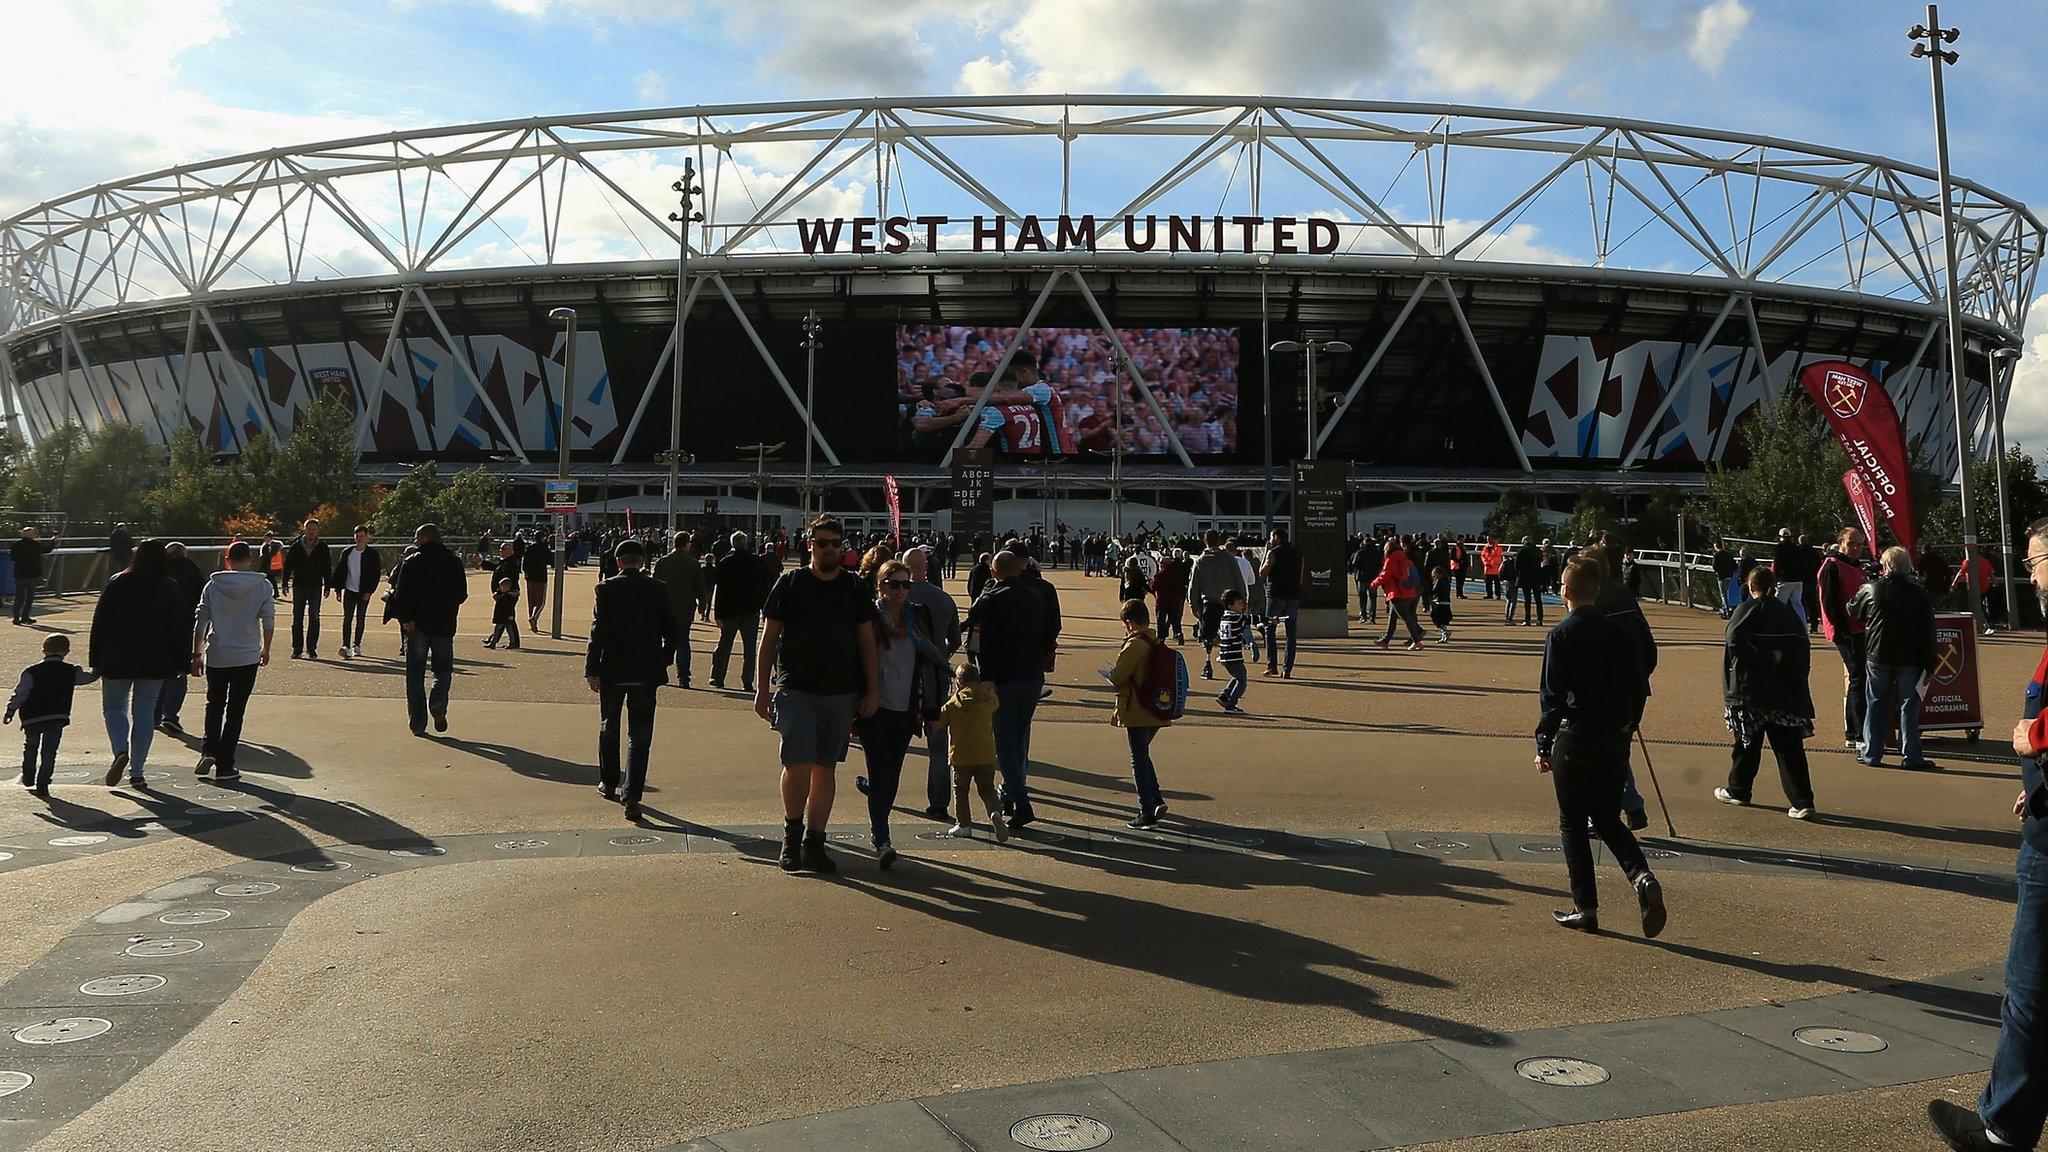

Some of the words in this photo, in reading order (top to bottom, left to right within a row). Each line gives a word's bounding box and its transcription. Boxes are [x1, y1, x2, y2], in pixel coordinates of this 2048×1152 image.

[797, 216, 948, 254] WEST
[973, 215, 1095, 253] HAM
[1124, 215, 1341, 255] UNITED
[332, 370, 347, 378] HAM
[1298, 471, 1304, 481] 1
[1932, 694, 1963, 703] OFFICIAL
[1925, 704, 1969, 713] PROGRAMME
